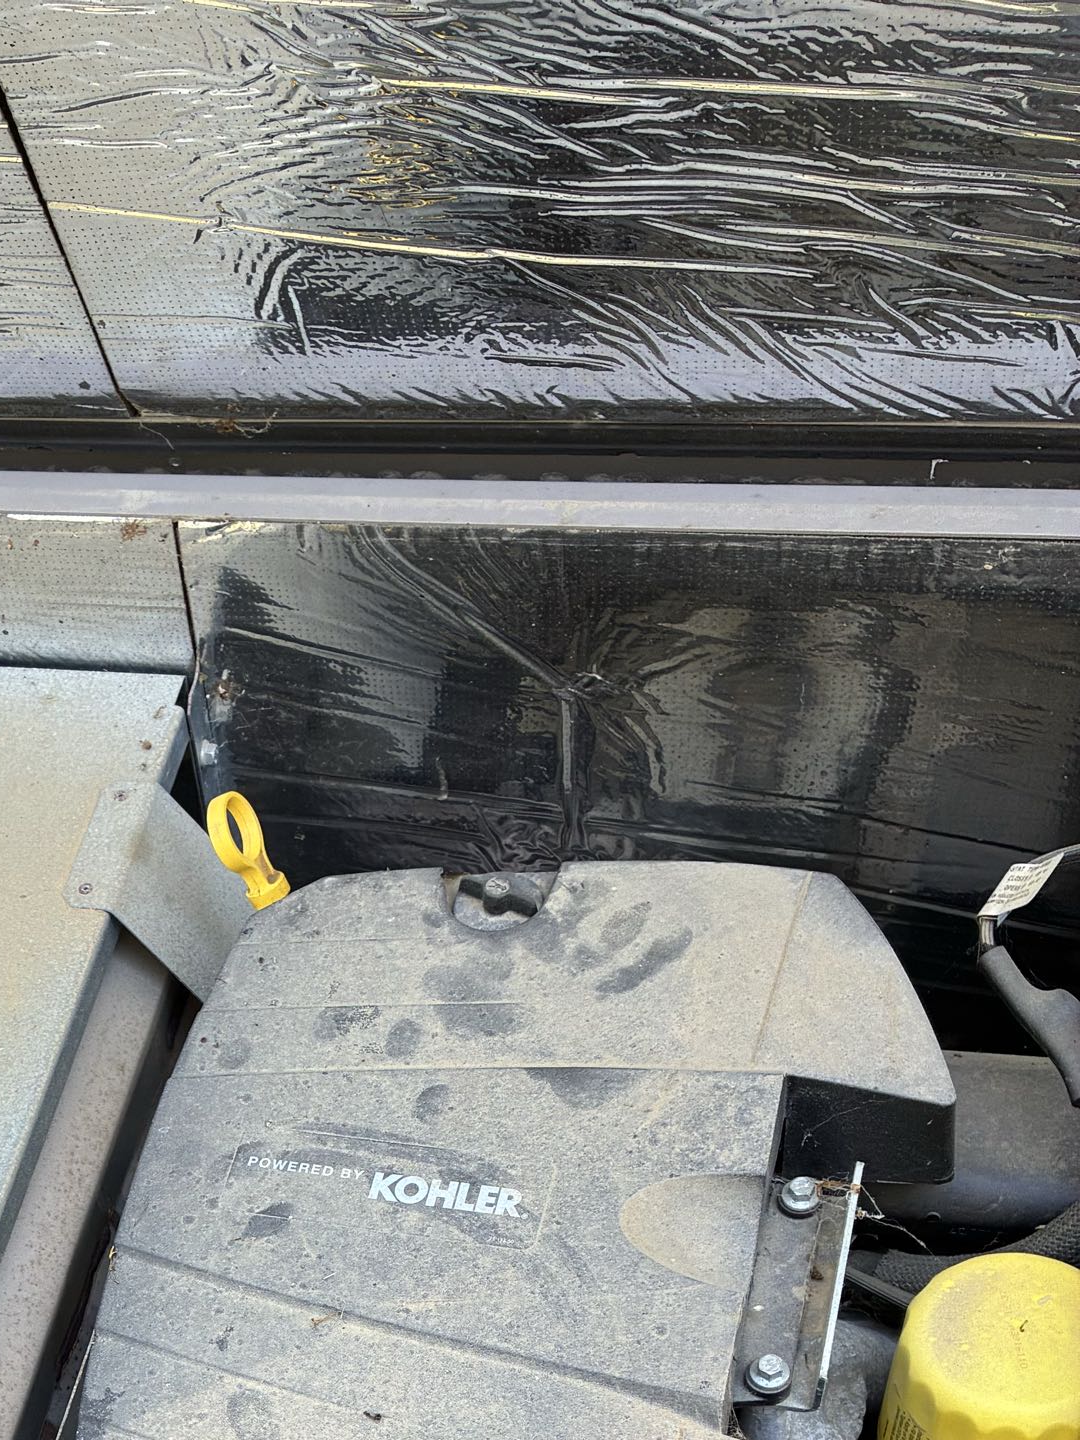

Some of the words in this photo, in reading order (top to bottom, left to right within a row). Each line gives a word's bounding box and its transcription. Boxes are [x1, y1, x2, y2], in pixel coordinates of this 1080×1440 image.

[247, 1156, 334, 1178] POWERED
[340, 1167, 365, 1181] BY
[367, 1171, 522, 1218] KOHLER
